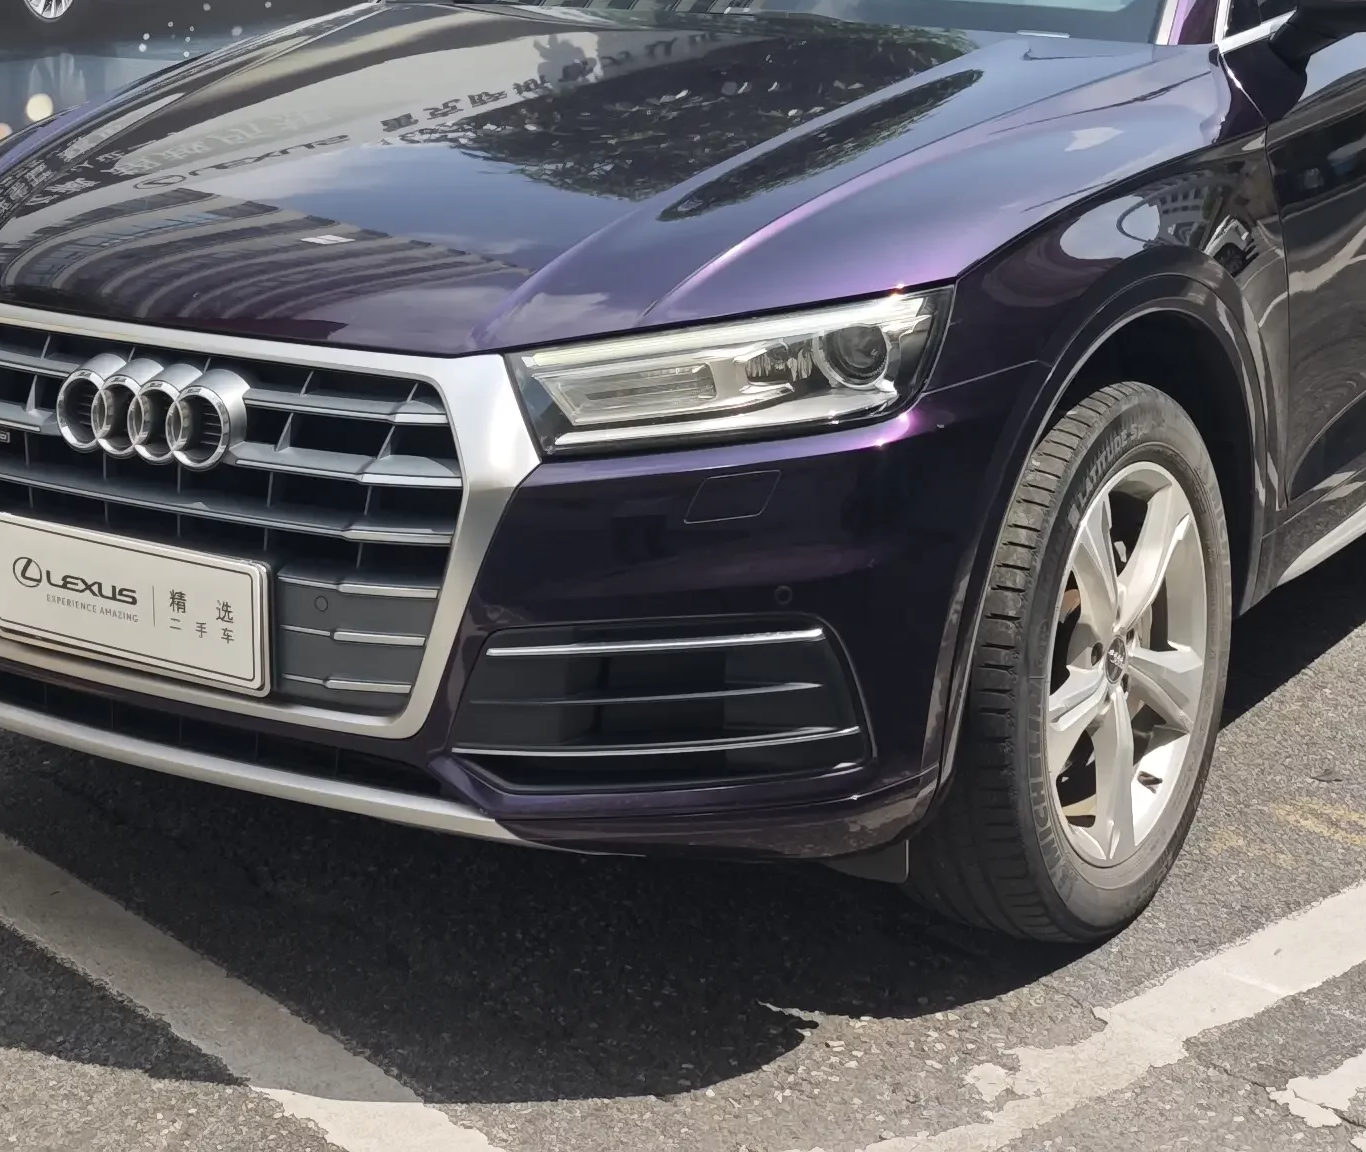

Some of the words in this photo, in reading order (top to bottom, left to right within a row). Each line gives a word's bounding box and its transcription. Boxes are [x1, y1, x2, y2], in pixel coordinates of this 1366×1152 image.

[46, 569, 138, 606] LEXUS
[46, 593, 98, 613] EXPERIENCE
[99, 606, 139, 623] AMAZING
